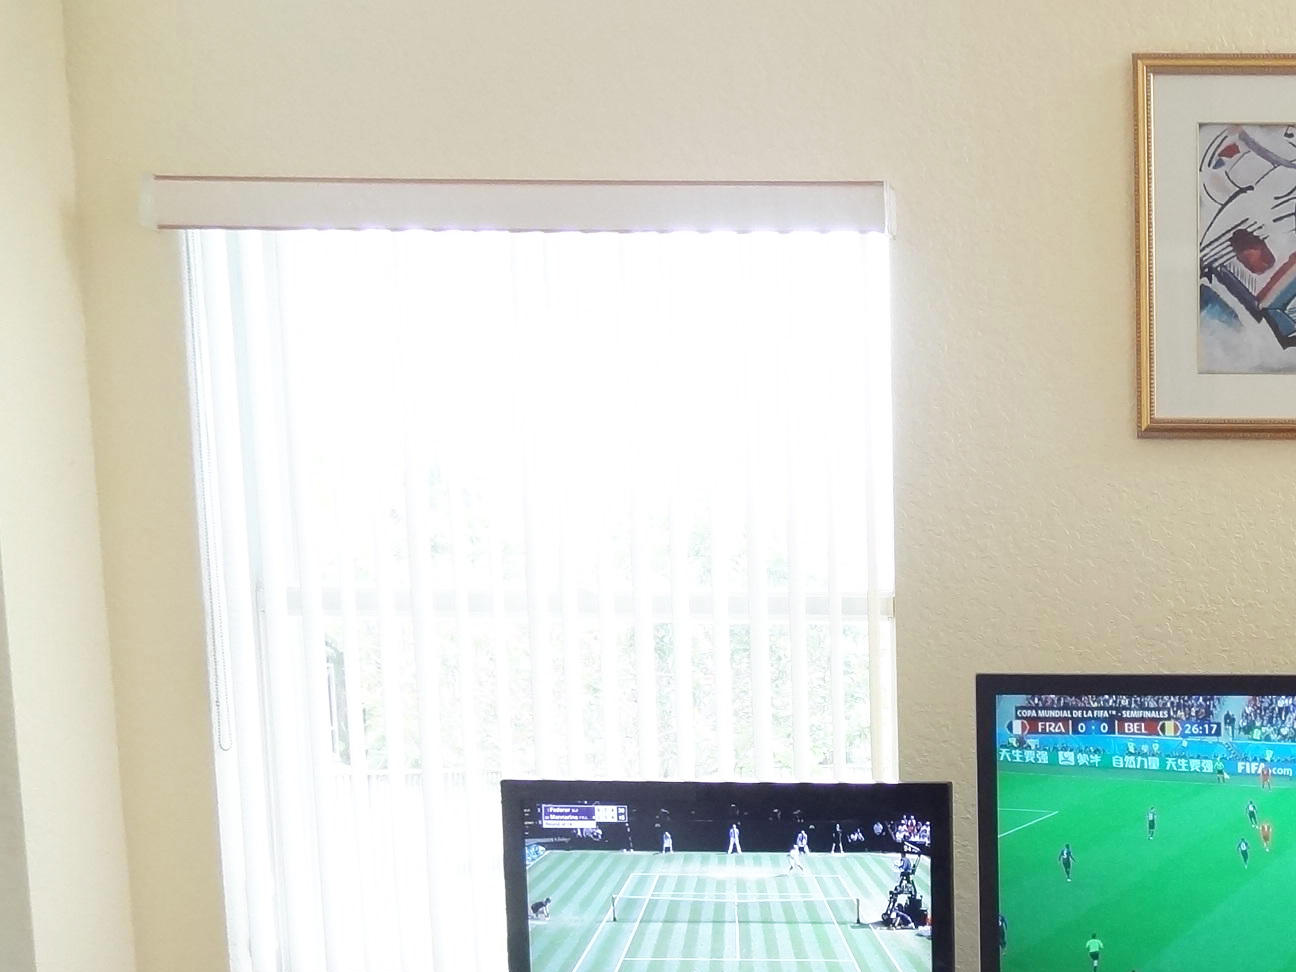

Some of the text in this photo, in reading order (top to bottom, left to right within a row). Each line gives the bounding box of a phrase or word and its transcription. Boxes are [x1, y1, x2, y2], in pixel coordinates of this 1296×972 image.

[1017, 710, 1037, 718] COPA
[1038, 710, 1072, 718] MUNDIAL
[1072, 710, 1083, 718] DE
[1083, 710, 1093, 718] LA
[1122, 710, 1169, 719] SEMIFINALES
[1038, 721, 1218, 735] FRA 0 0 BEL 26:17
